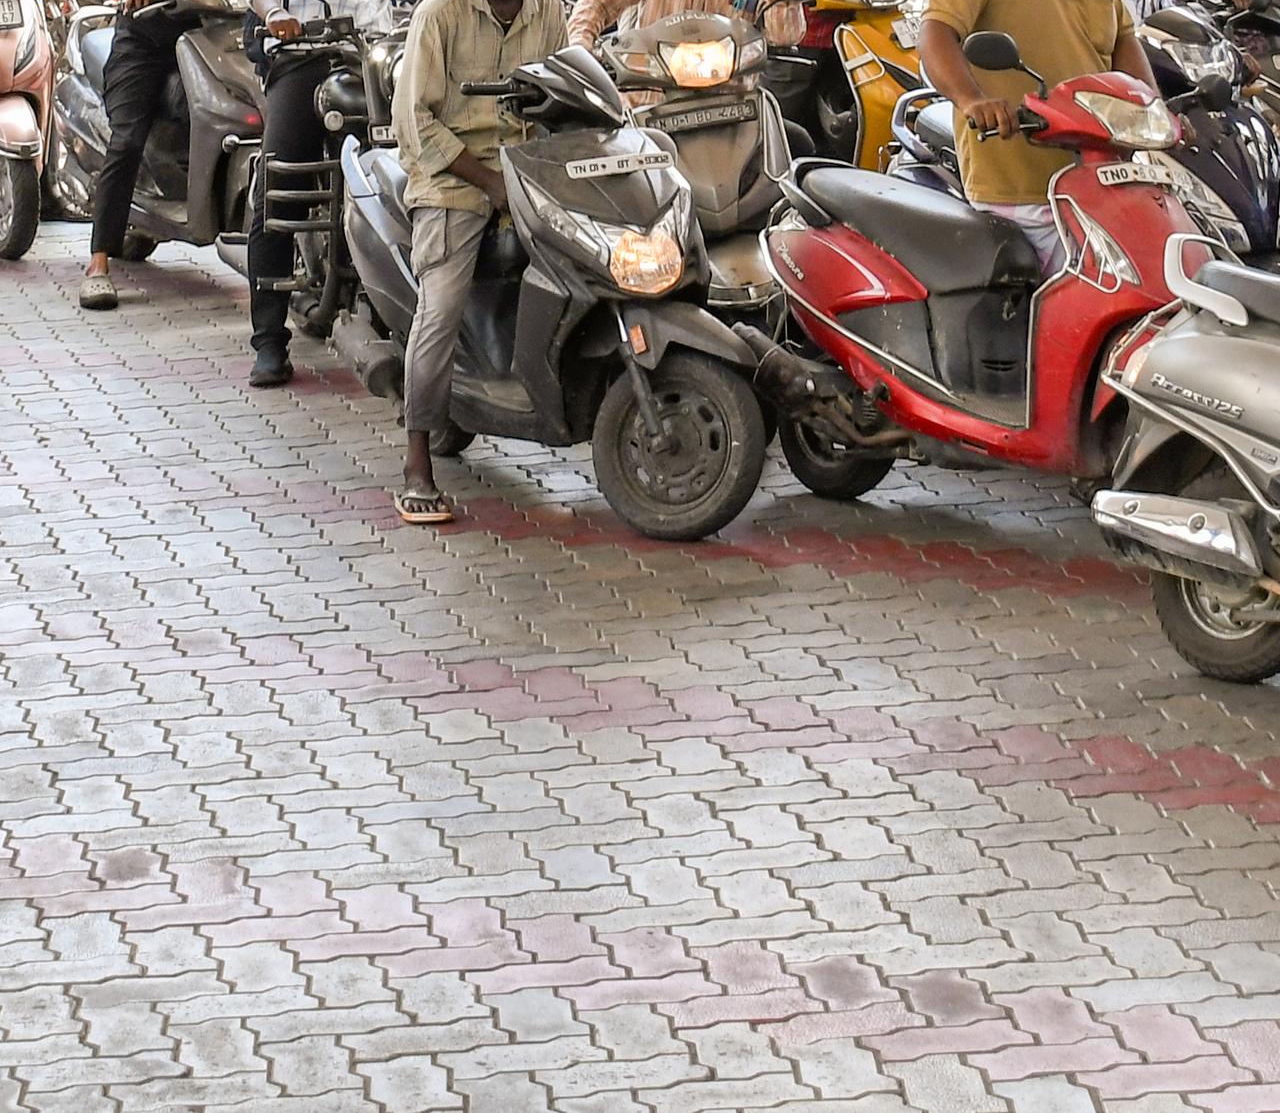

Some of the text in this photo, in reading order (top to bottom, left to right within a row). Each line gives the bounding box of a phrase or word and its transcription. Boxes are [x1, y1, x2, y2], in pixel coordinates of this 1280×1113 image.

[573, 164, 587, 174] TN
[589, 163, 599, 173] 01
[645, 154, 670, 165] 9302
[776, 239, 805, 281] Pleasure
